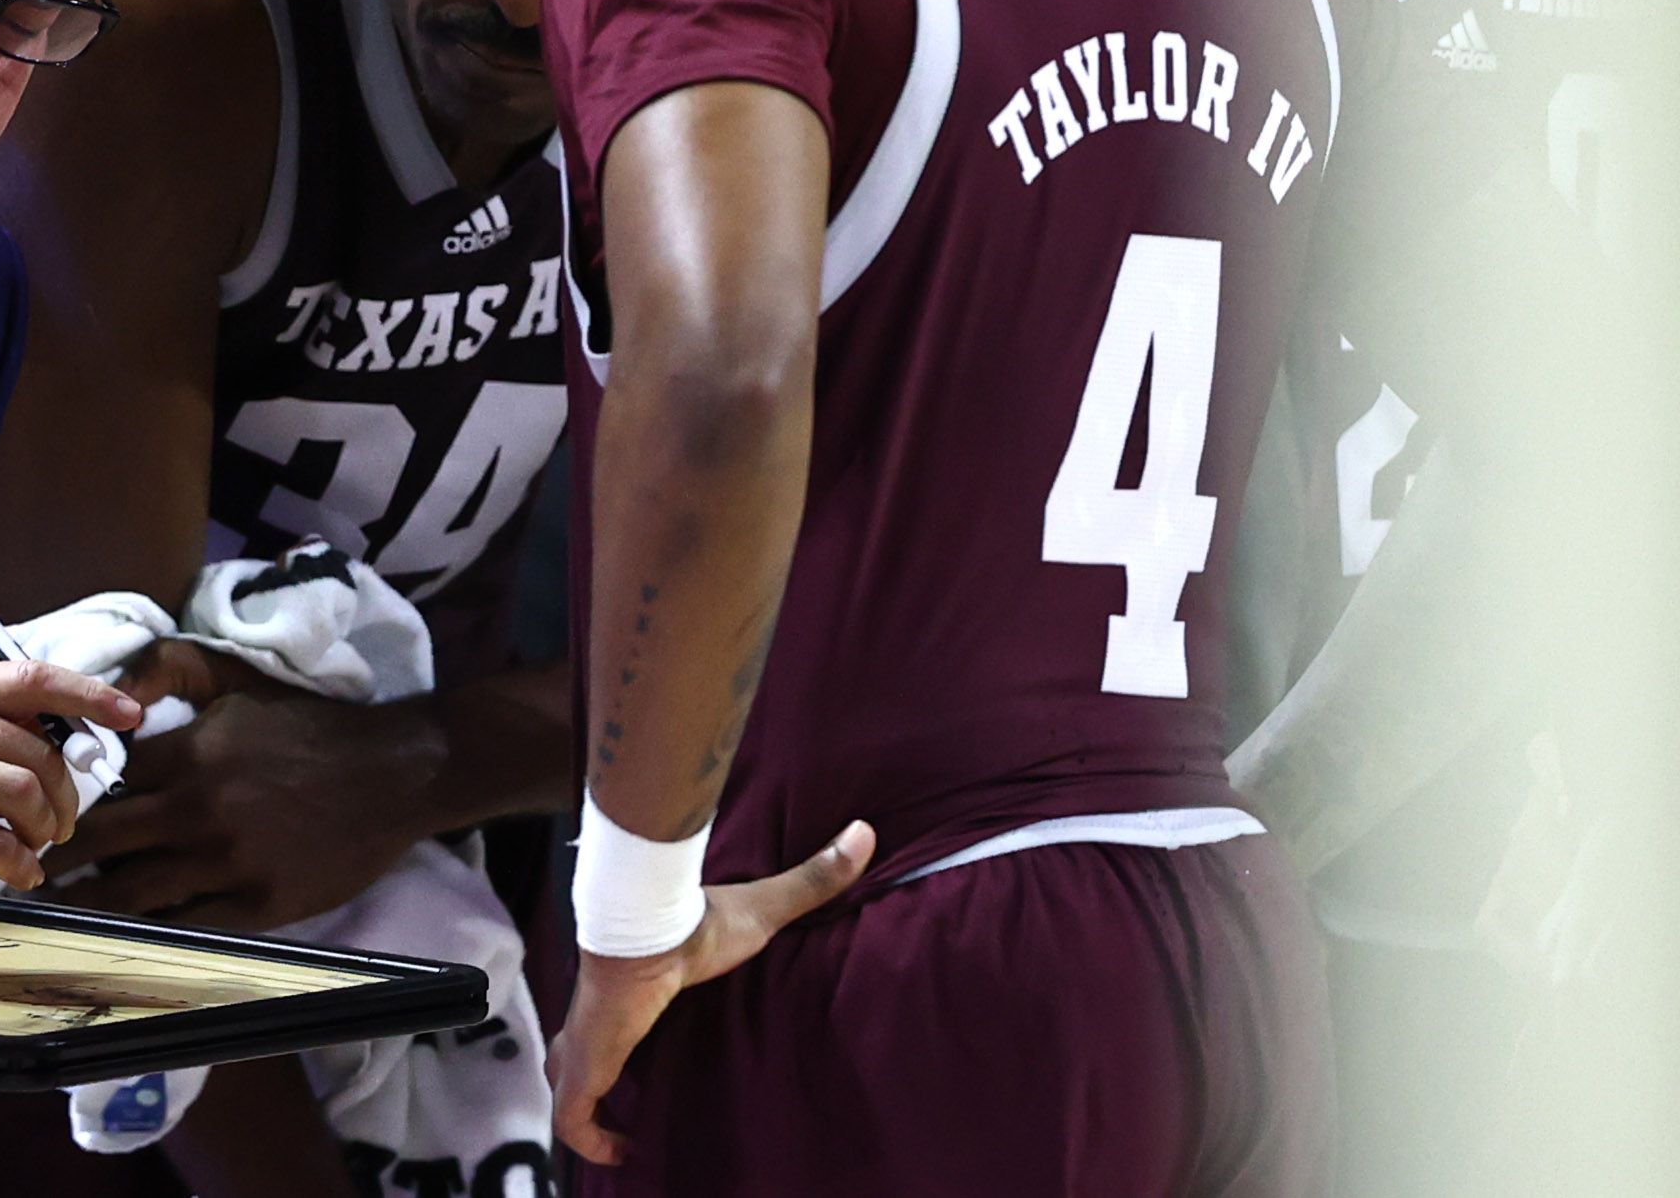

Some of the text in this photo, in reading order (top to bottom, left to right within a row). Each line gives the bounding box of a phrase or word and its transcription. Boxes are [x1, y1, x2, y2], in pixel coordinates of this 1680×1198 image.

[988, 31, 1313, 205] TAYLOR IV
[276, 281, 510, 372] TEXAS
[225, 380, 569, 602] 34
[1042, 233, 1222, 699] 4
